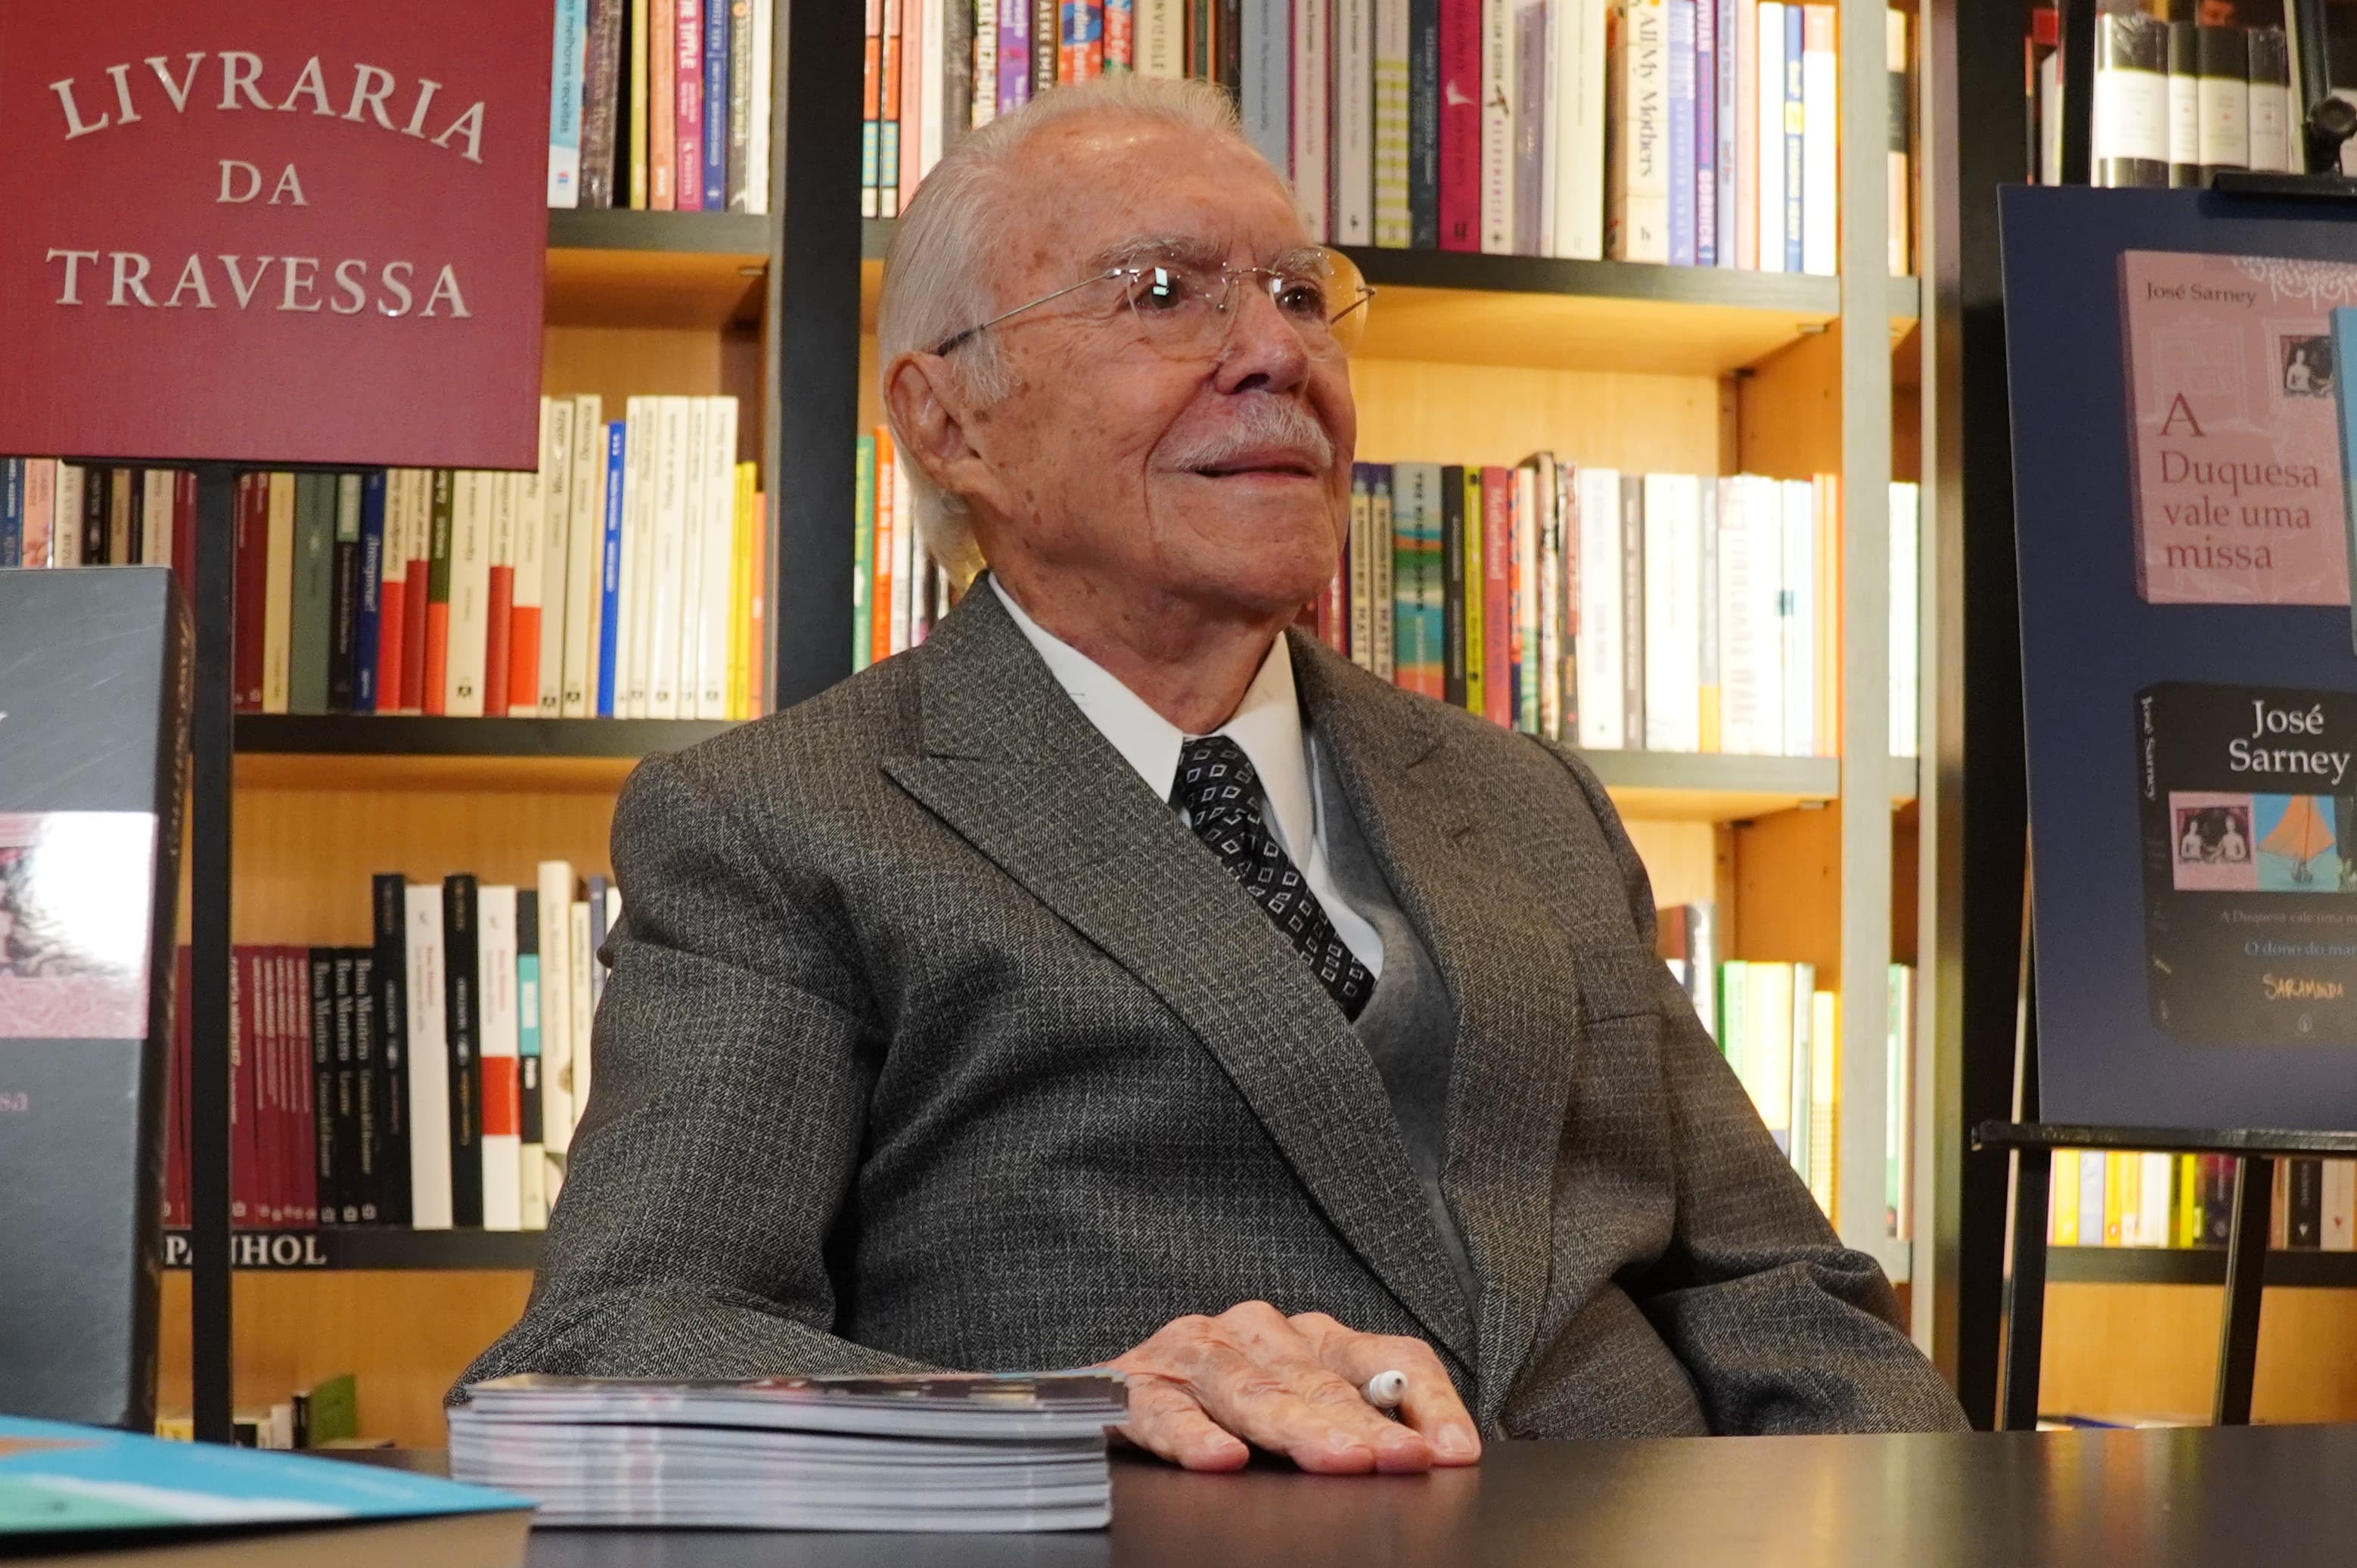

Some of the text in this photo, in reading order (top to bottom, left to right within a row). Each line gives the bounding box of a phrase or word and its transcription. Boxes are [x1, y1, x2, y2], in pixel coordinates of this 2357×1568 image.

[50, 51, 486, 165] LIVRARIA
[1632, 11, 1659, 177] All My Mothers
[216, 160, 309, 206] DA
[45, 248, 472, 318] TRAVESSA
[2145, 282, 2258, 309] José Sarney
[2157, 392, 2206, 438] A
[2160, 450, 2319, 497] Duquesa
[2163, 495, 2312, 529] vale uma
[2166, 536, 2274, 570] missa
[2251, 700, 2325, 738] José
[2228, 738, 2350, 785] Sarney
[337, 958, 352, 995] Rosa
[356, 958, 374, 995] Rosa
[337, 995, 354, 1061] Montero
[357, 995, 374, 1060] Montero
[165, 1235, 328, 1265] PHOL
